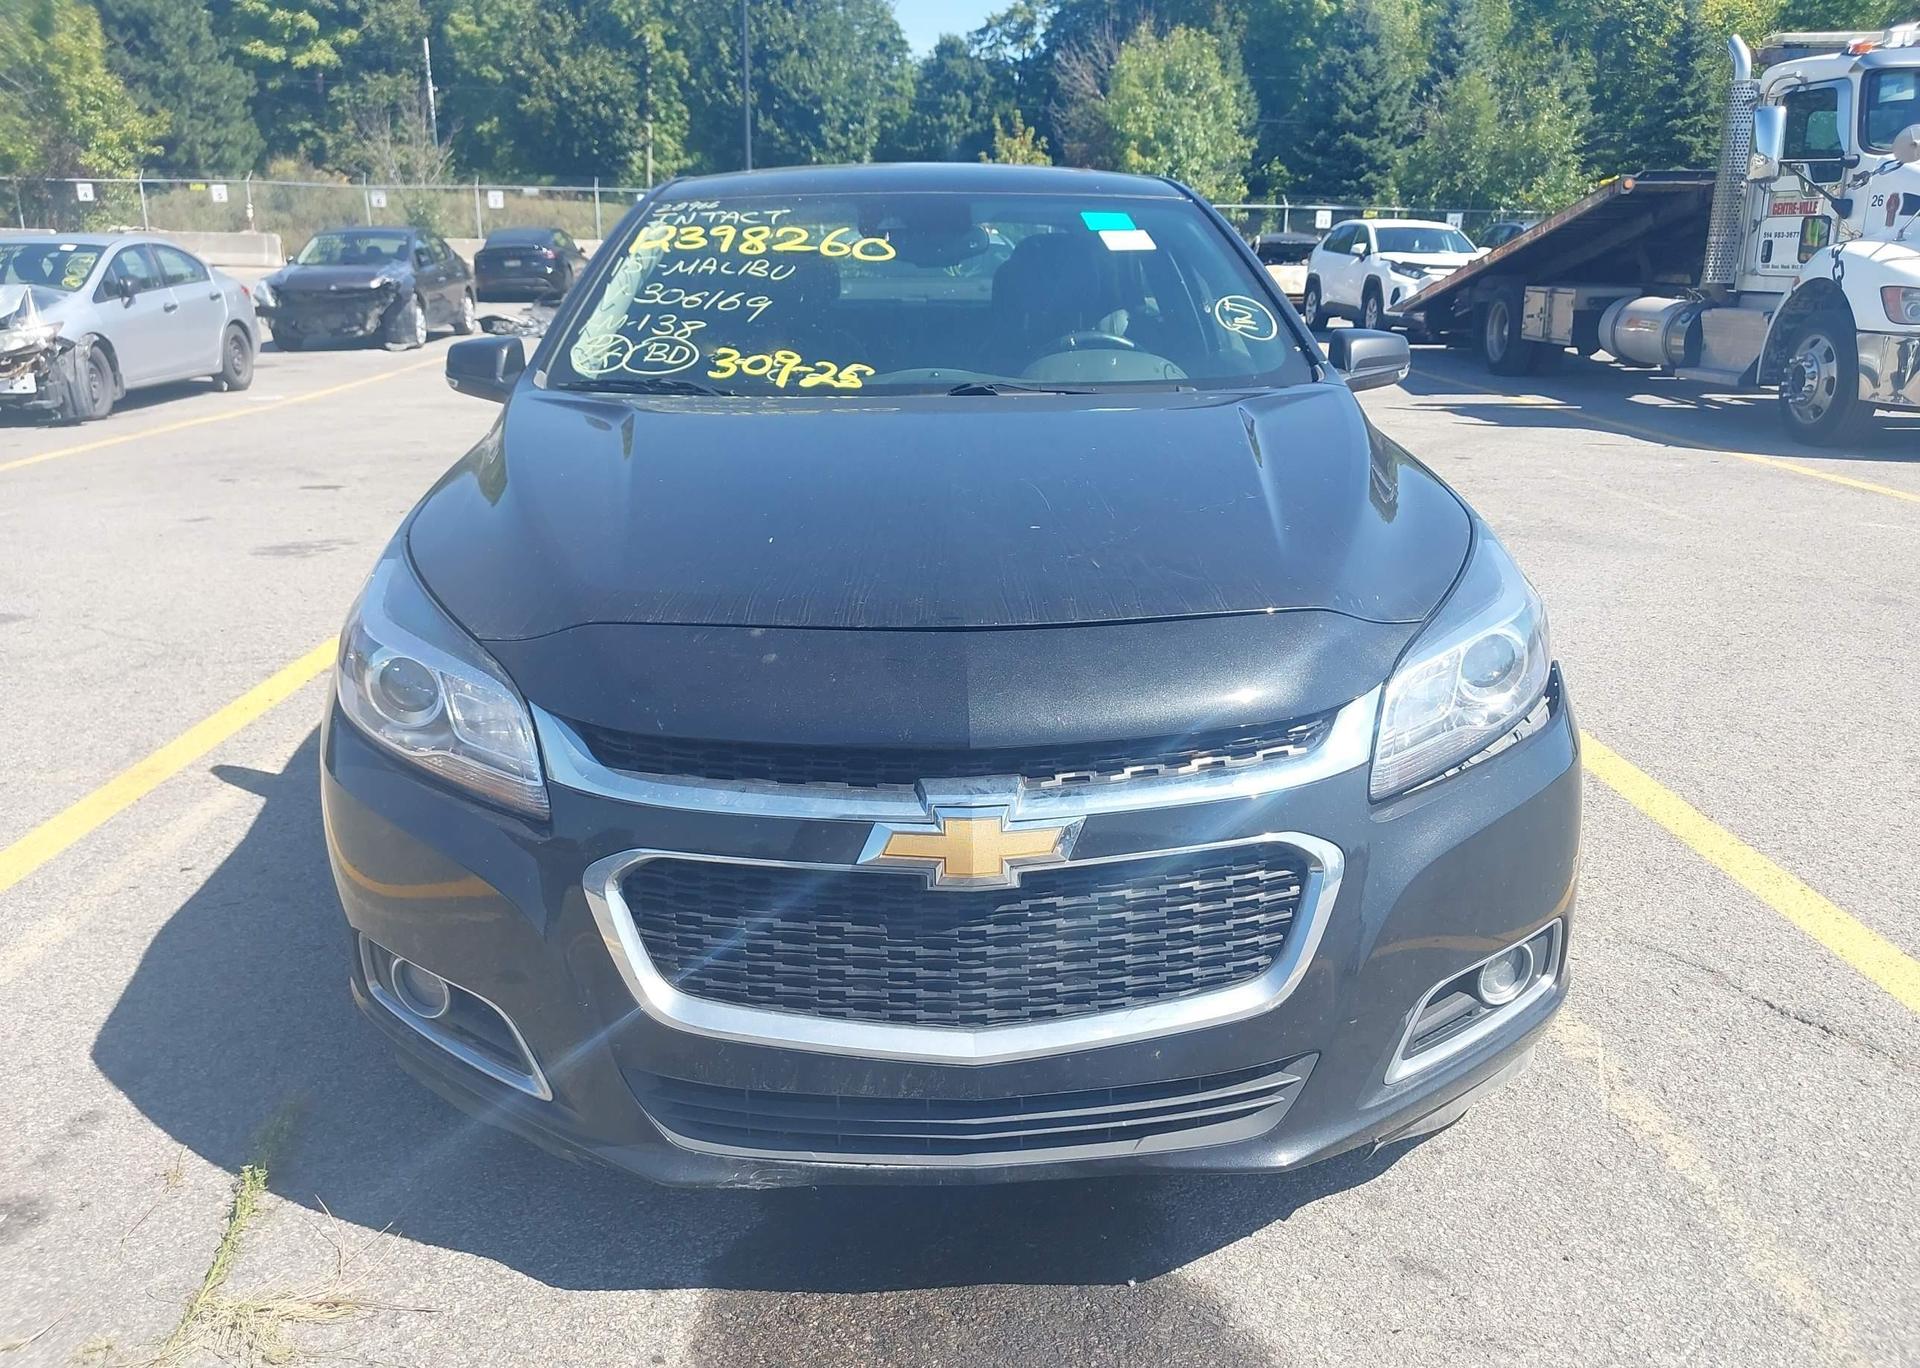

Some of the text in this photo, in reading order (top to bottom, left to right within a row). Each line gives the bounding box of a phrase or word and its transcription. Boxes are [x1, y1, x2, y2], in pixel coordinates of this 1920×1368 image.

[1772, 201, 1818, 215] CENTRE-VILLE
[1871, 194, 1884, 207] 26
[649, 209, 791, 225] INTACT
[643, 342, 690, 364] BD
